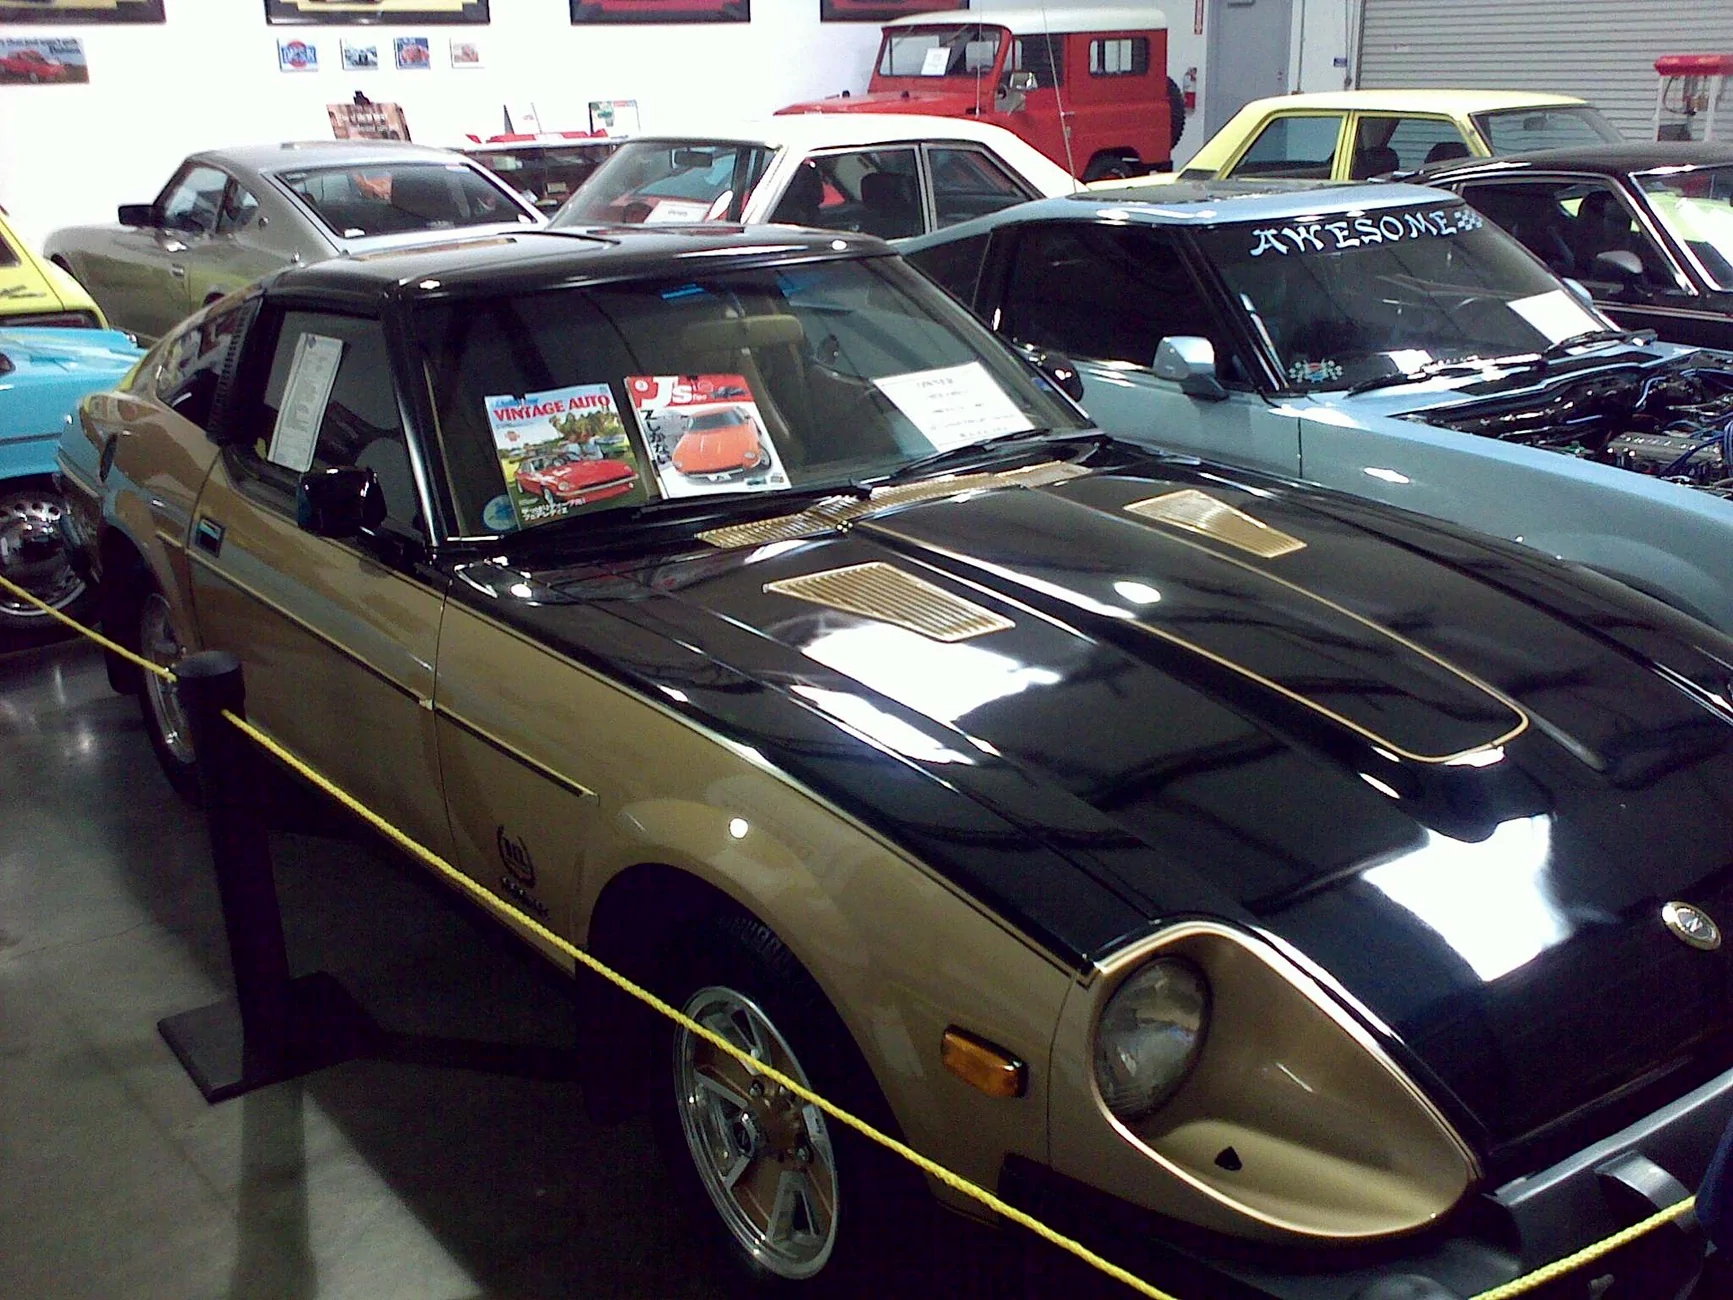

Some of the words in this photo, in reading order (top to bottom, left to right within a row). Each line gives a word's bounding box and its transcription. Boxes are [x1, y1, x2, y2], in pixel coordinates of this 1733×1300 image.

[1249, 210, 1458, 257] AWESOME
[493, 400, 564, 422] VINTAGE
[568, 394, 611, 411] AUTO
